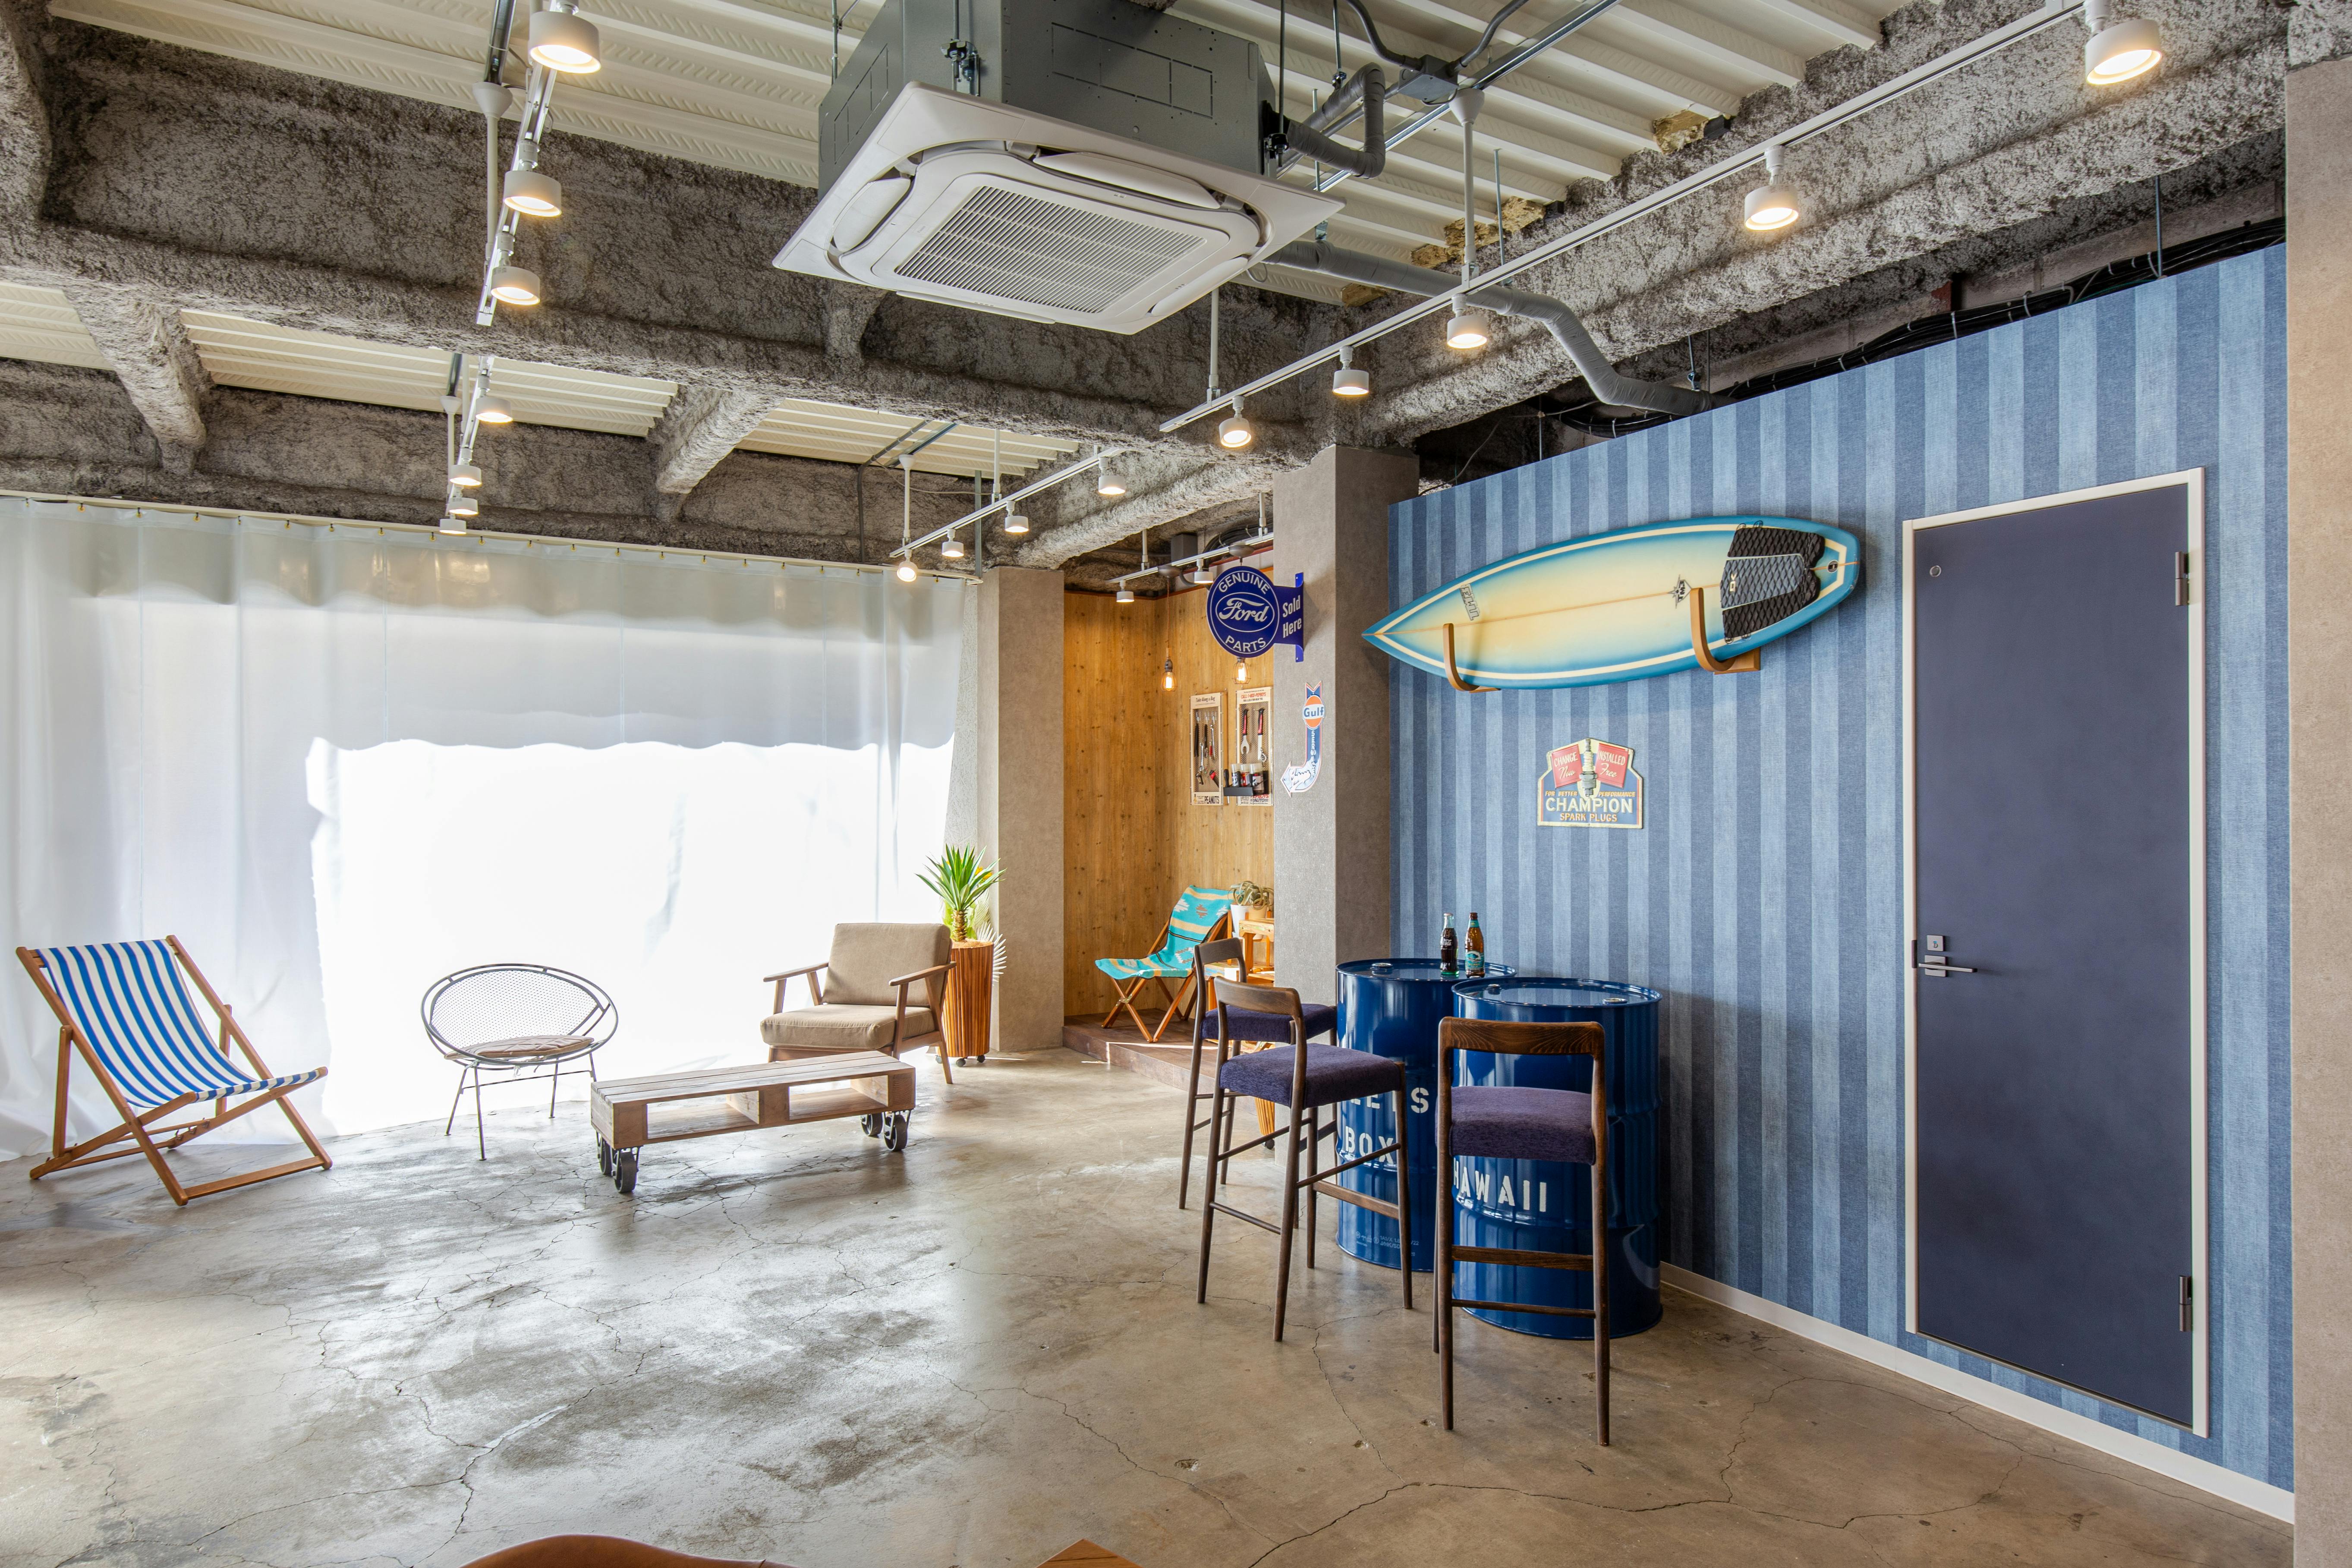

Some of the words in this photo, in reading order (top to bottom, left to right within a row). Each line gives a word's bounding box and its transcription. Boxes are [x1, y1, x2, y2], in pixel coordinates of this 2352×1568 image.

[1219, 573, 1270, 594] GENUINE
[1219, 598, 1269, 622] Ford
[1282, 595, 1300, 618] Sold
[1283, 618, 1302, 638] Here
[1225, 635, 1266, 652] PARTS
[1304, 707, 1324, 717] Gulf
[1554, 752, 1578, 767] CHANGE
[1598, 750, 1626, 765] INSTALLED
[1559, 765, 1576, 779] Now
[1600, 762, 1618, 777] Free
[1205, 796, 1219, 804] PEANUTS
[1546, 797, 1633, 813] CHAMPION
[1560, 813, 1586, 821] SPARK
[1590, 813, 1617, 822] PLUGS
[1345, 1126, 1394, 1165] BOX
[1454, 1157, 1547, 1212] HAWAII
